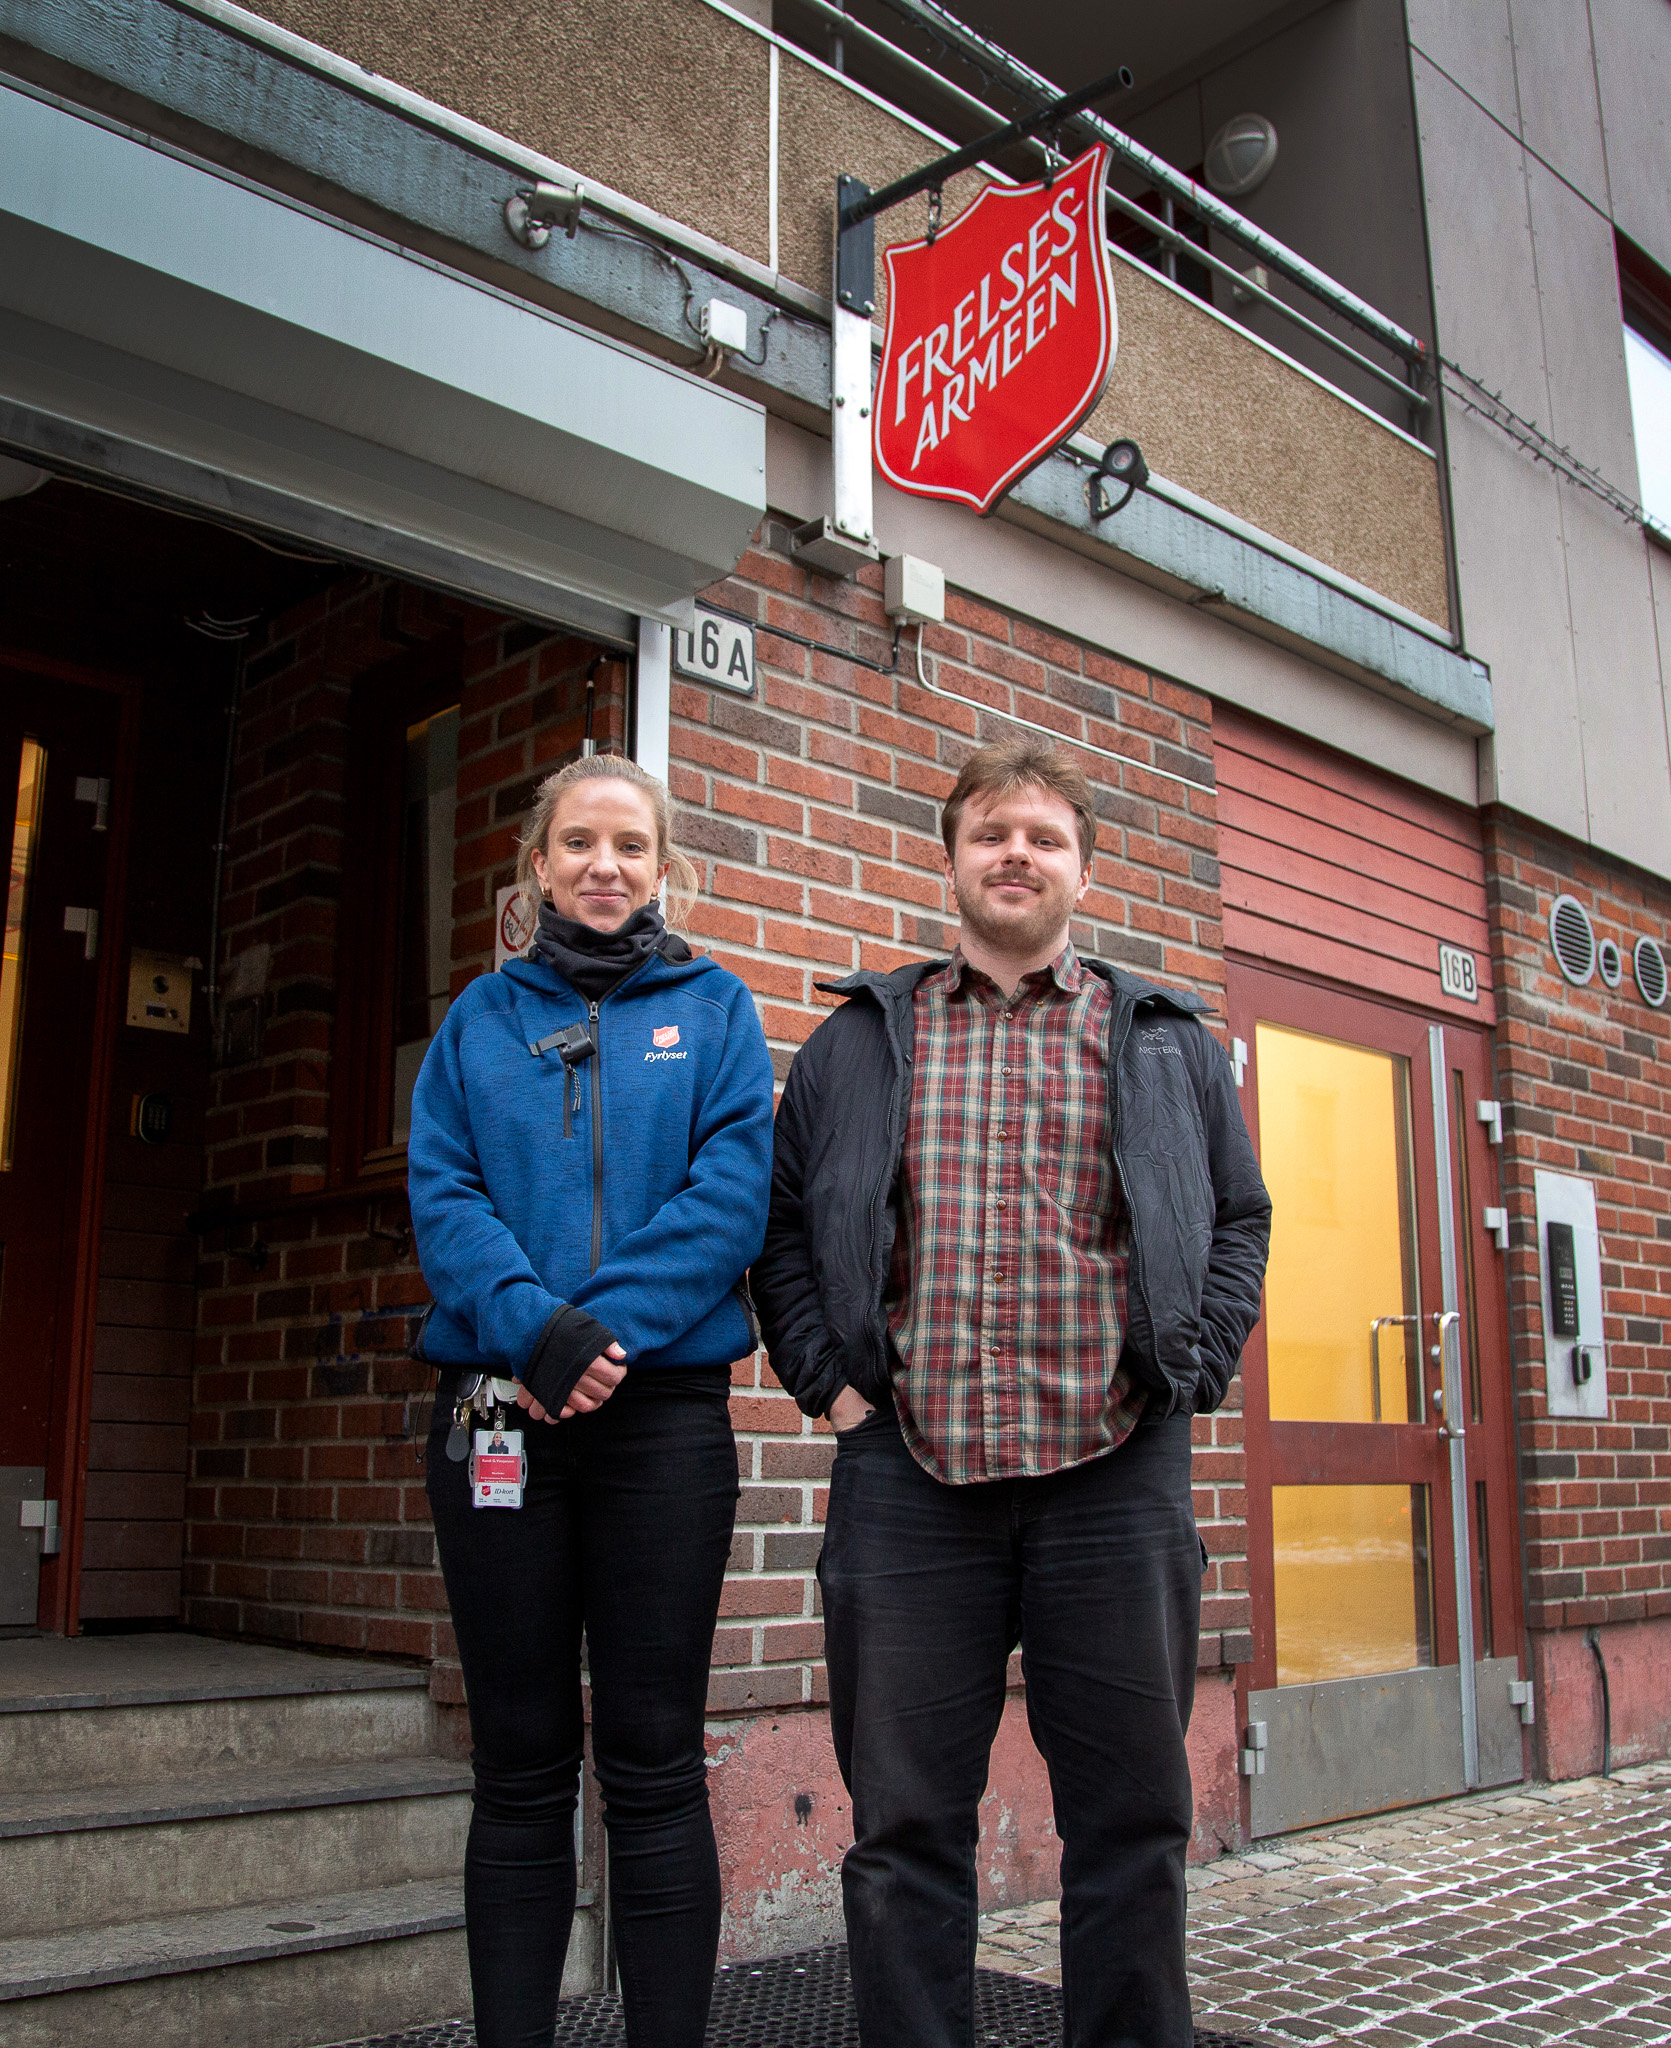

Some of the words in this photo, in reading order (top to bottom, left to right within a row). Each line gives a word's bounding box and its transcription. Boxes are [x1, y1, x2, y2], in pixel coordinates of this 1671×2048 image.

[895, 187, 1084, 427] FRELSES-
[910, 250, 1078, 471] ARMEEN
[688, 619, 749, 683] 16A
[1443, 951, 1474, 993] 16B
[644, 1050, 688, 1063] Fyrlyset
